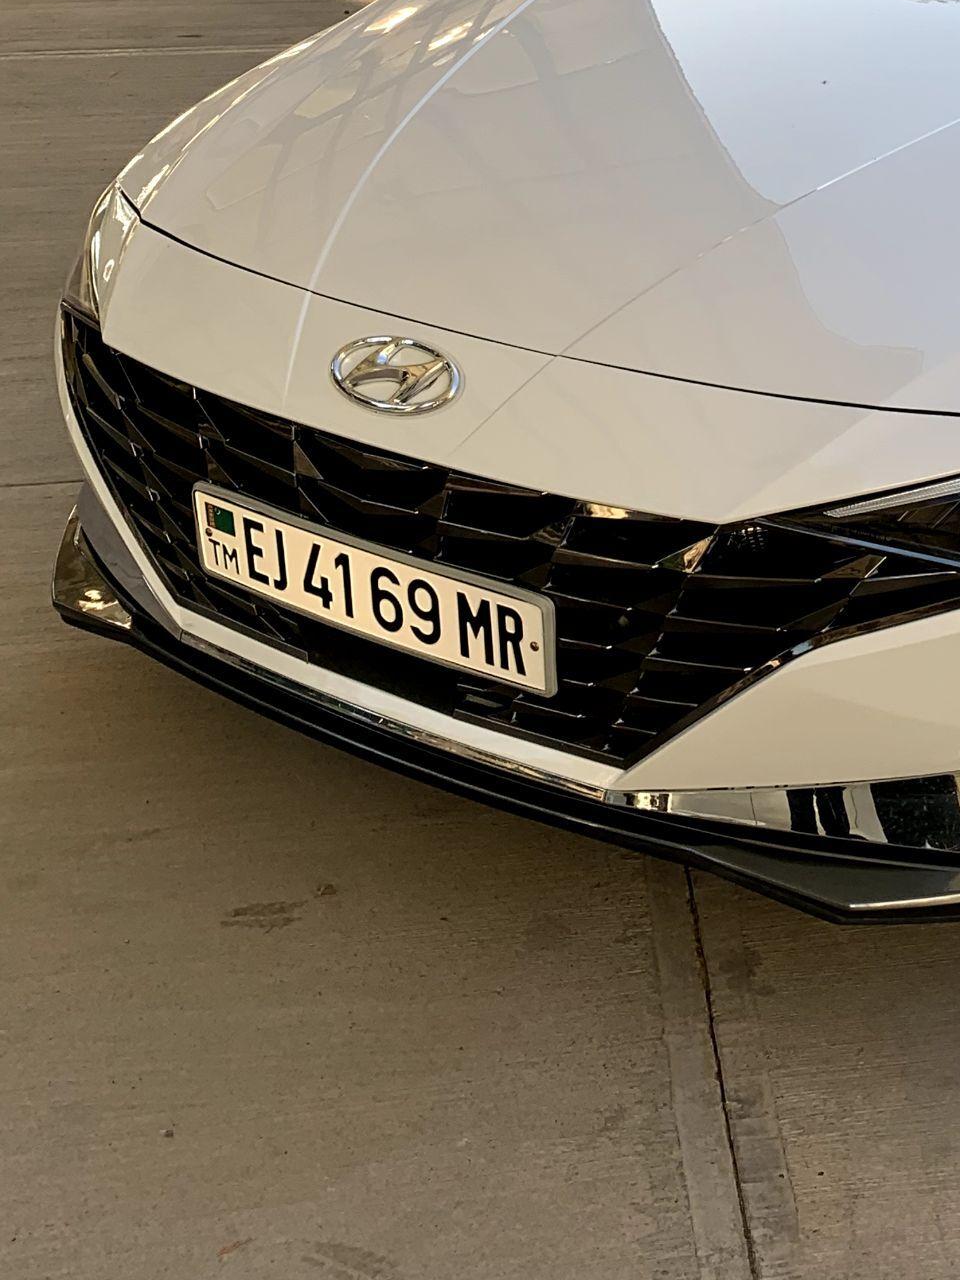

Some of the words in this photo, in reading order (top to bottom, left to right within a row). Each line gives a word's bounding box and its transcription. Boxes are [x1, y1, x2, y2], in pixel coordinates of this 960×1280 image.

[207, 537, 240, 575] TM
[242, 516, 288, 592] EJ
[456, 591, 527, 677] MR
